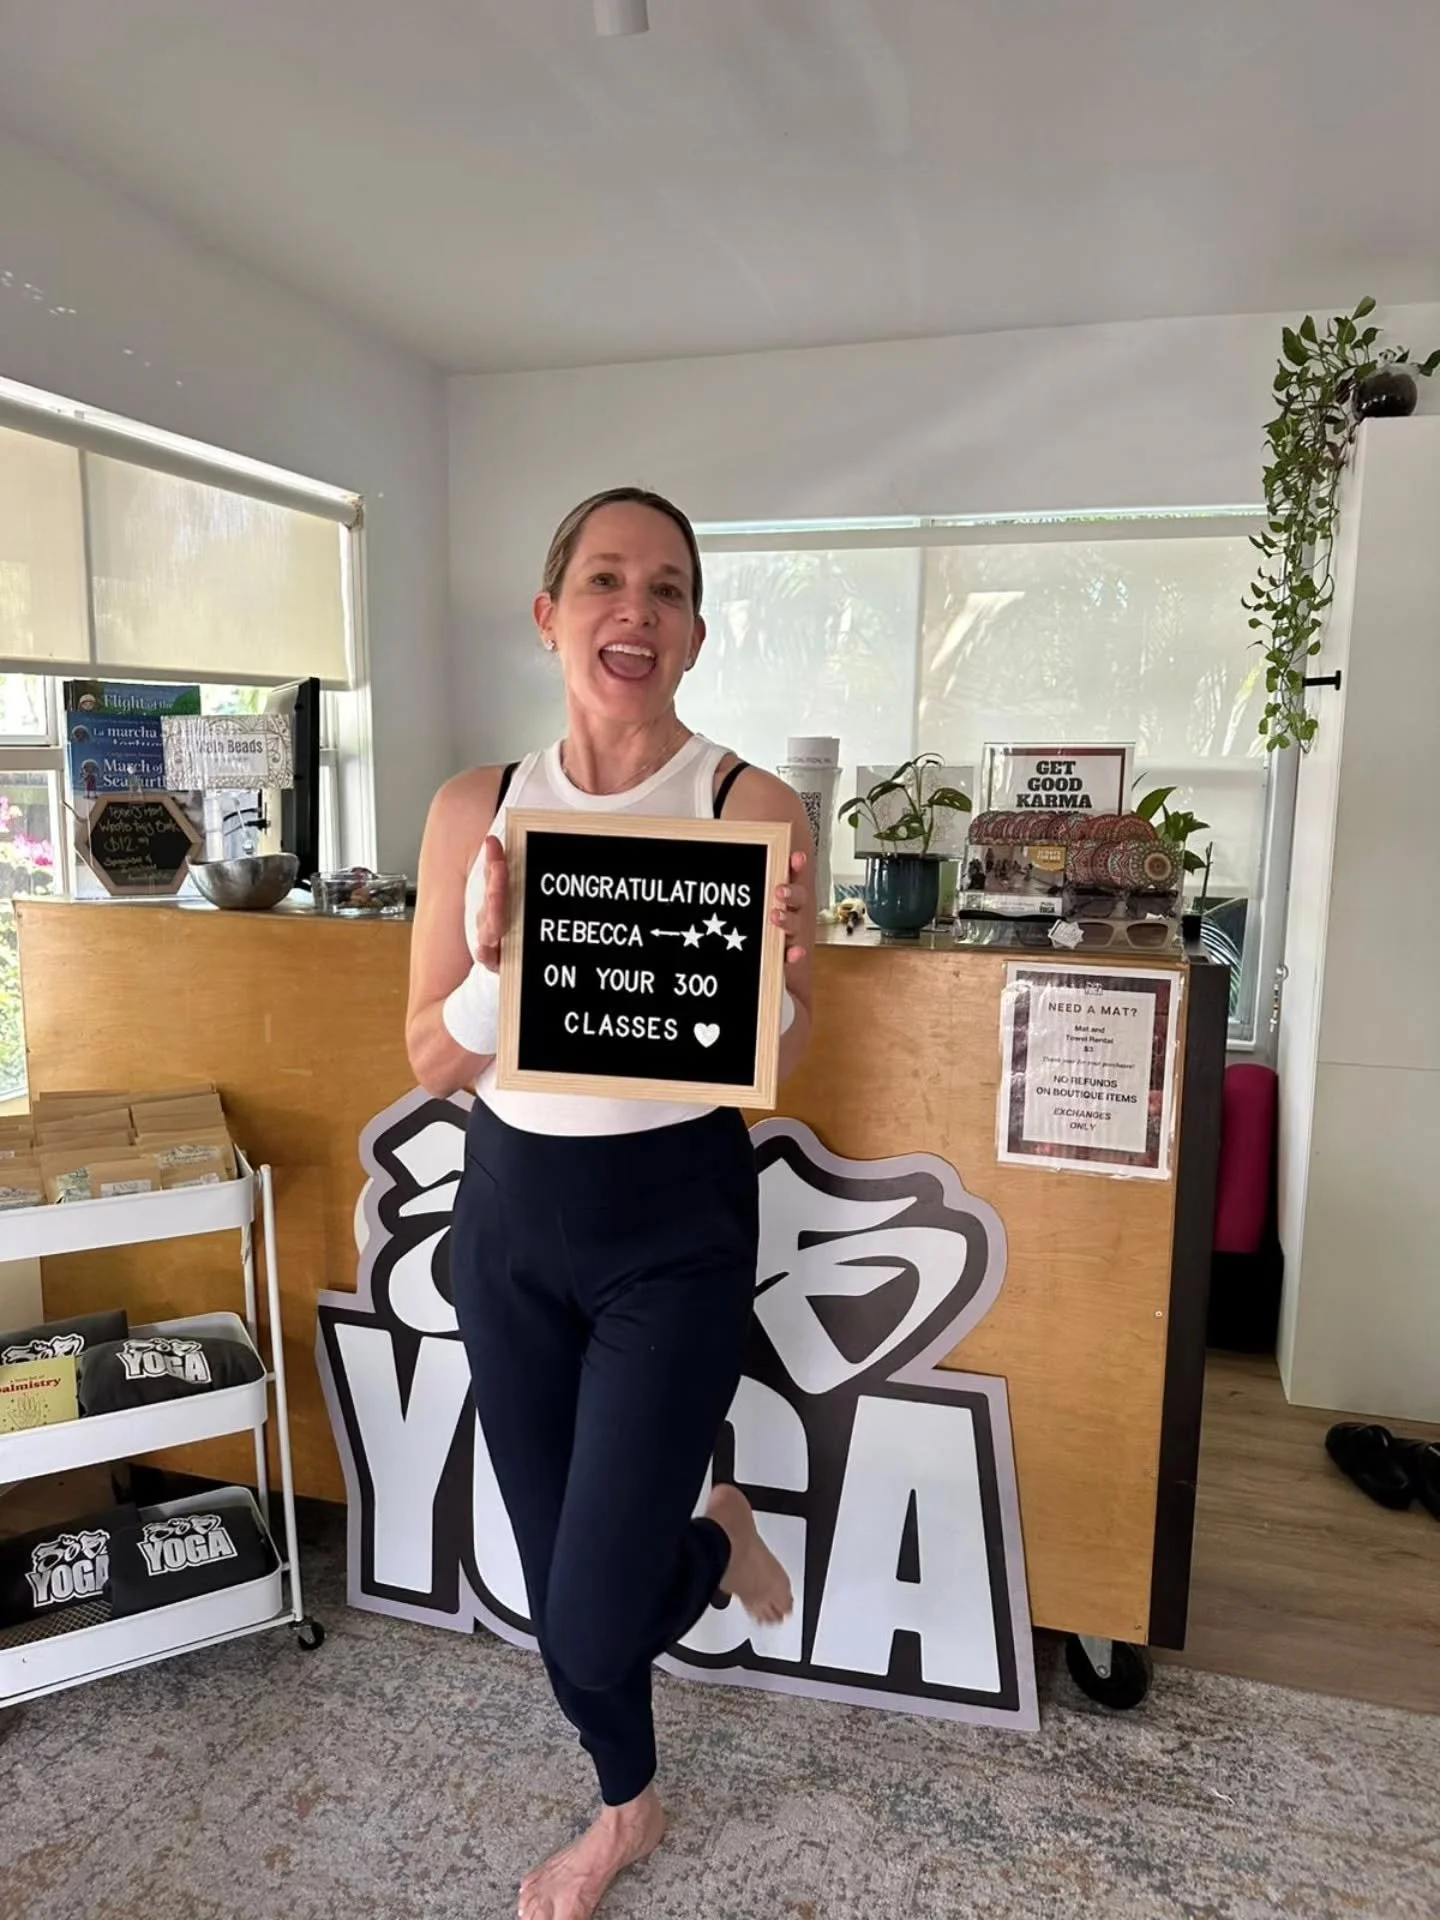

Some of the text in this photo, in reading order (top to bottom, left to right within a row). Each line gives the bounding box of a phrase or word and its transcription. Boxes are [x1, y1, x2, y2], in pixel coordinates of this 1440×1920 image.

[104, 694, 146, 712] Flight
[108, 725, 157, 739] marcha
[227, 739, 264, 754] Beads
[1036, 760, 1076, 775] GET
[103, 774, 129, 788] Sea
[1027, 777, 1083, 792] GOOD
[1016, 793, 1093, 809] KARMA
[540, 873, 751, 907] CONGRATULATIONS
[540, 919, 643, 947] REBECCA
[544, 964, 718, 997] ON YOUR 300
[1048, 1002, 1138, 1017] NEED A MAT?
[564, 1011, 678, 1040] CLASSES
[1074, 1025, 1105, 1034] Mat and
[1066, 1034, 1114, 1044] Towel Rental
[1053, 1074, 1118, 1089] NO REFUNDS
[1036, 1086, 1138, 1104] ON BOUTIQUE ITEMS
[1053, 1107, 1112, 1121] EXCHANGES
[1069, 1121, 1097, 1132] ONLY
[121, 1349, 209, 1382] YOGA
[143, 1528, 233, 1573] YOGA
